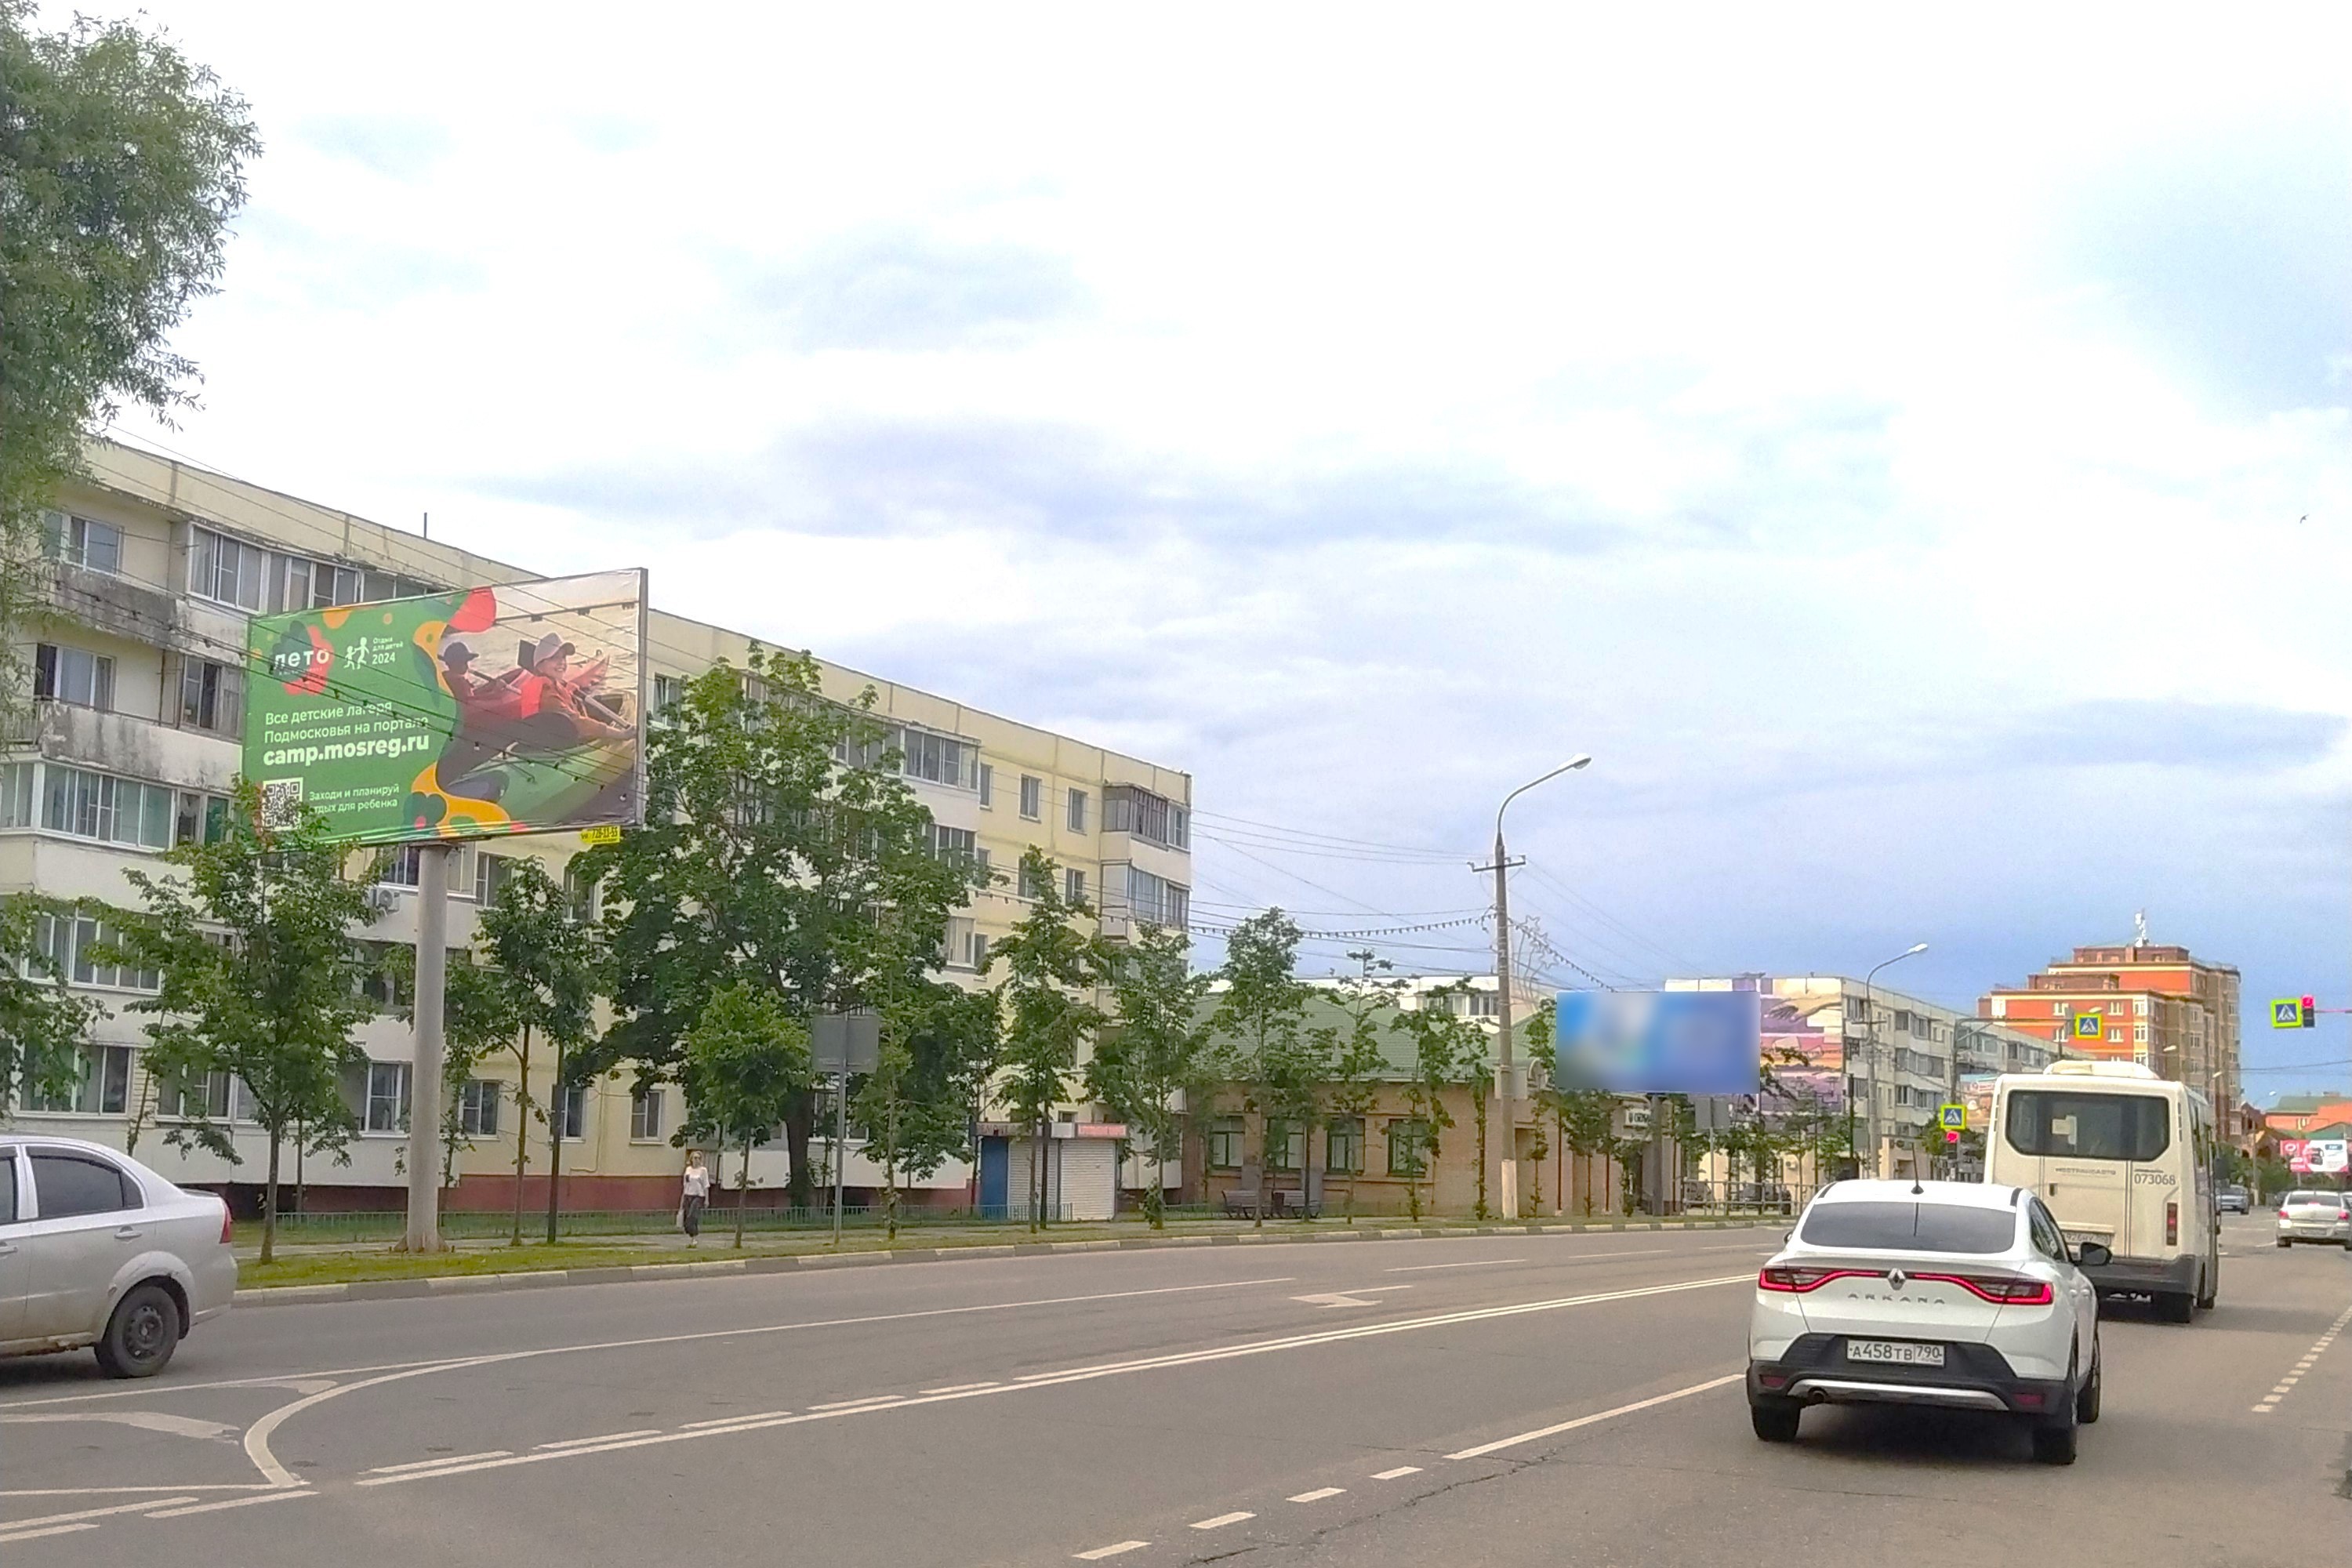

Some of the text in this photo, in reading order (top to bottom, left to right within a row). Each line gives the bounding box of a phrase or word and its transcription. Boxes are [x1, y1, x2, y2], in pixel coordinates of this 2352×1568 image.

[372, 652, 396, 665] 2024
[266, 702, 392, 725] Все детские лагеря
[264, 724, 351, 744] Подмосковья
[354, 722, 370, 735] на
[263, 735, 430, 766] camp.mosreg.ru
[309, 783, 400, 800] Заходи и планируй
[313, 798, 398, 815] тдых для ребенка
[2134, 1174, 2176, 1185] 073068
[1848, 1293, 1945, 1304] ARKANA
[1853, 1343, 1940, 1361] А458ТВ 790
